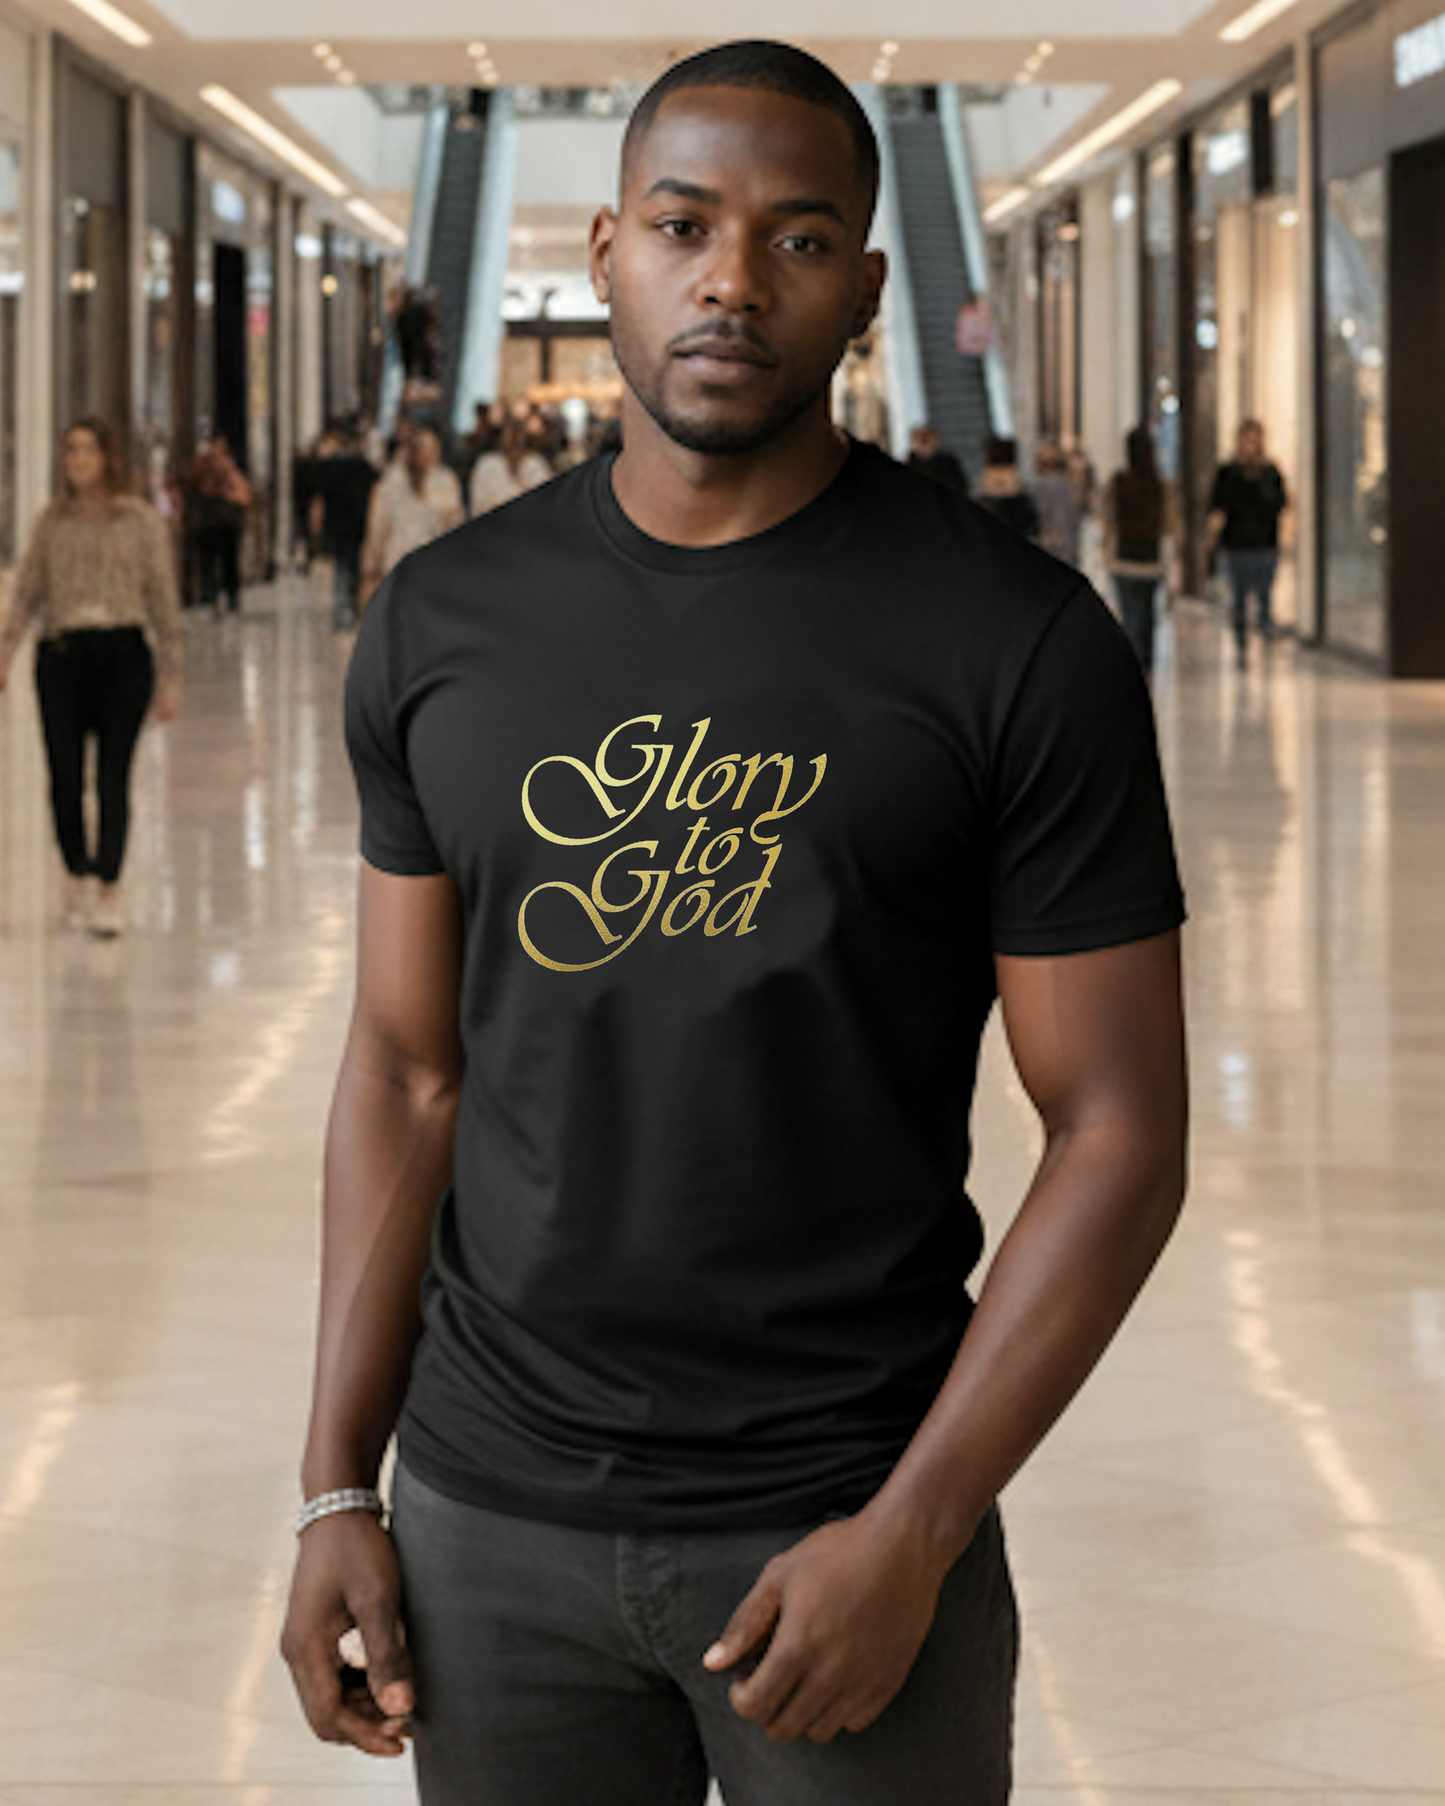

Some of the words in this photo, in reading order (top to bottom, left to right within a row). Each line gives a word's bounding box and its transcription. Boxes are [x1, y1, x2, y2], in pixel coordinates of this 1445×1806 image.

[522, 714, 827, 845] Glory
[518, 840, 783, 972] God
[675, 817, 744, 875] to
